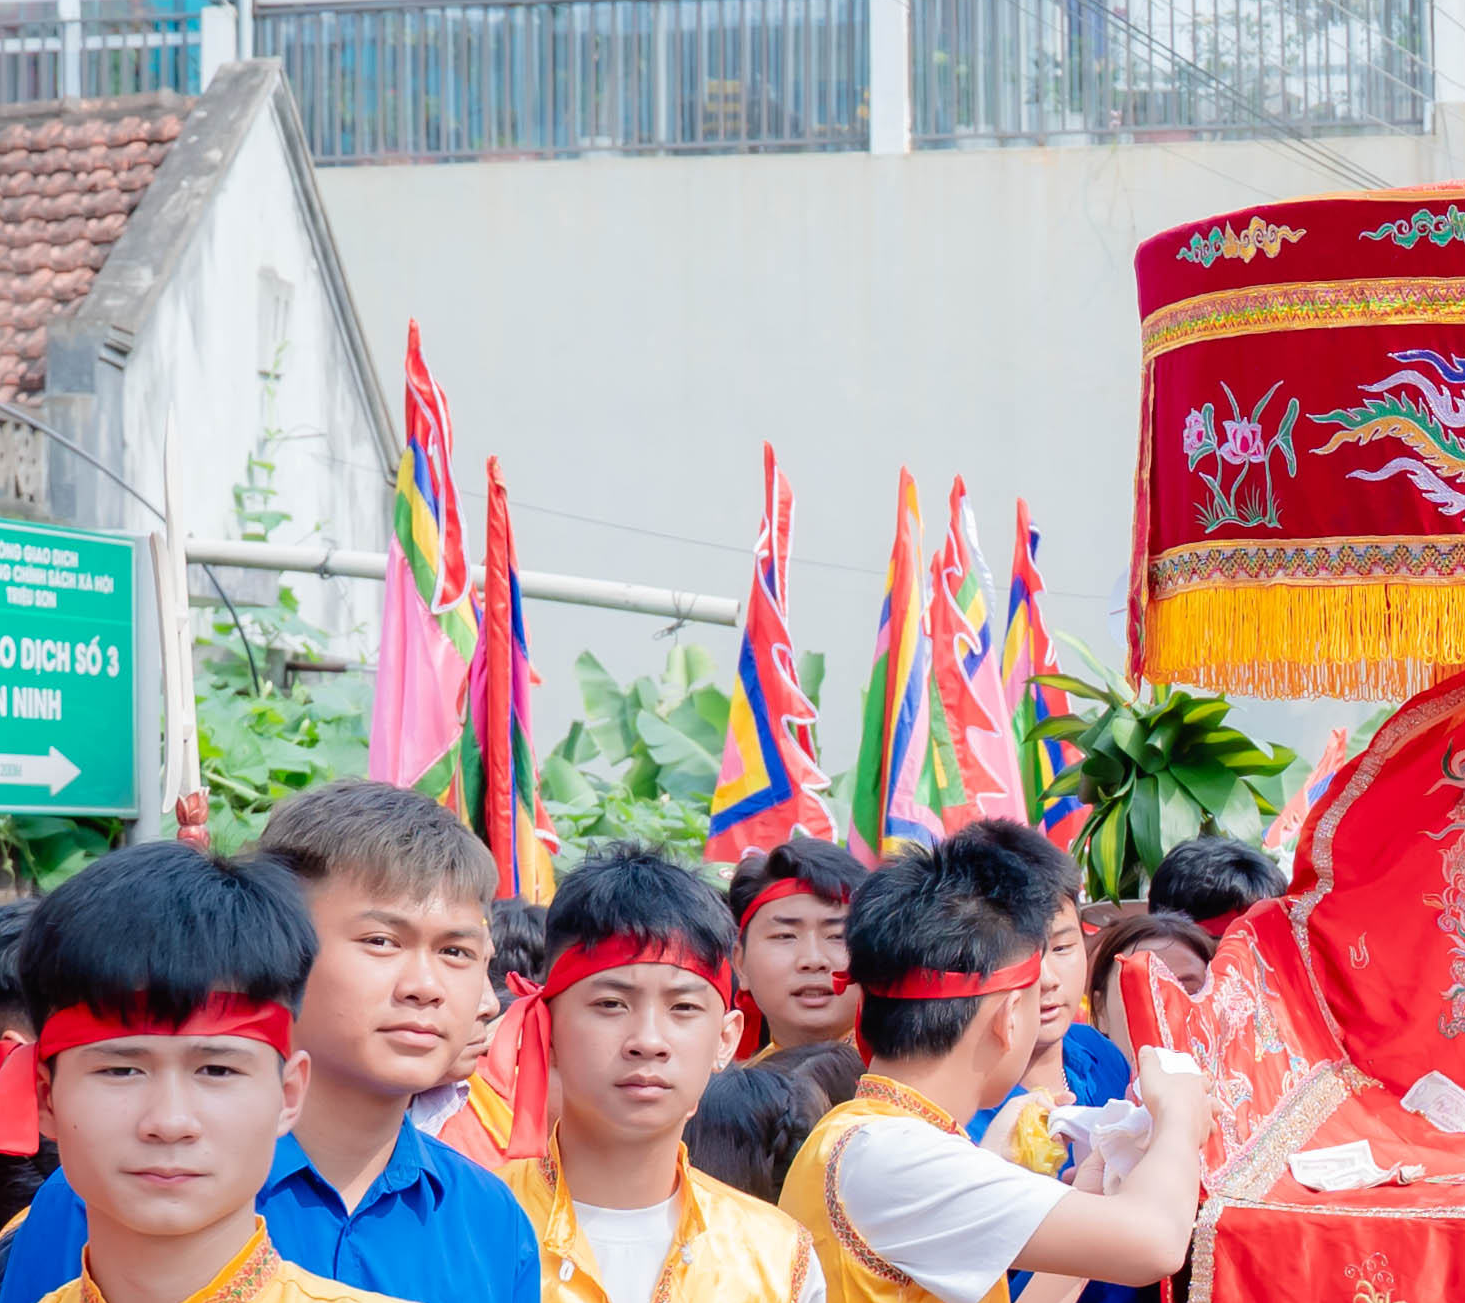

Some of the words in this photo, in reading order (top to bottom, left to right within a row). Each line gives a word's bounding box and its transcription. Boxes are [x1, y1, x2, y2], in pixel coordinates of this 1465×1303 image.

[20, 637, 71, 675] DỊCH
[75, 635, 102, 676] SỐ
[106, 645, 120, 678] 3
[12, 686, 62, 721] NINH
